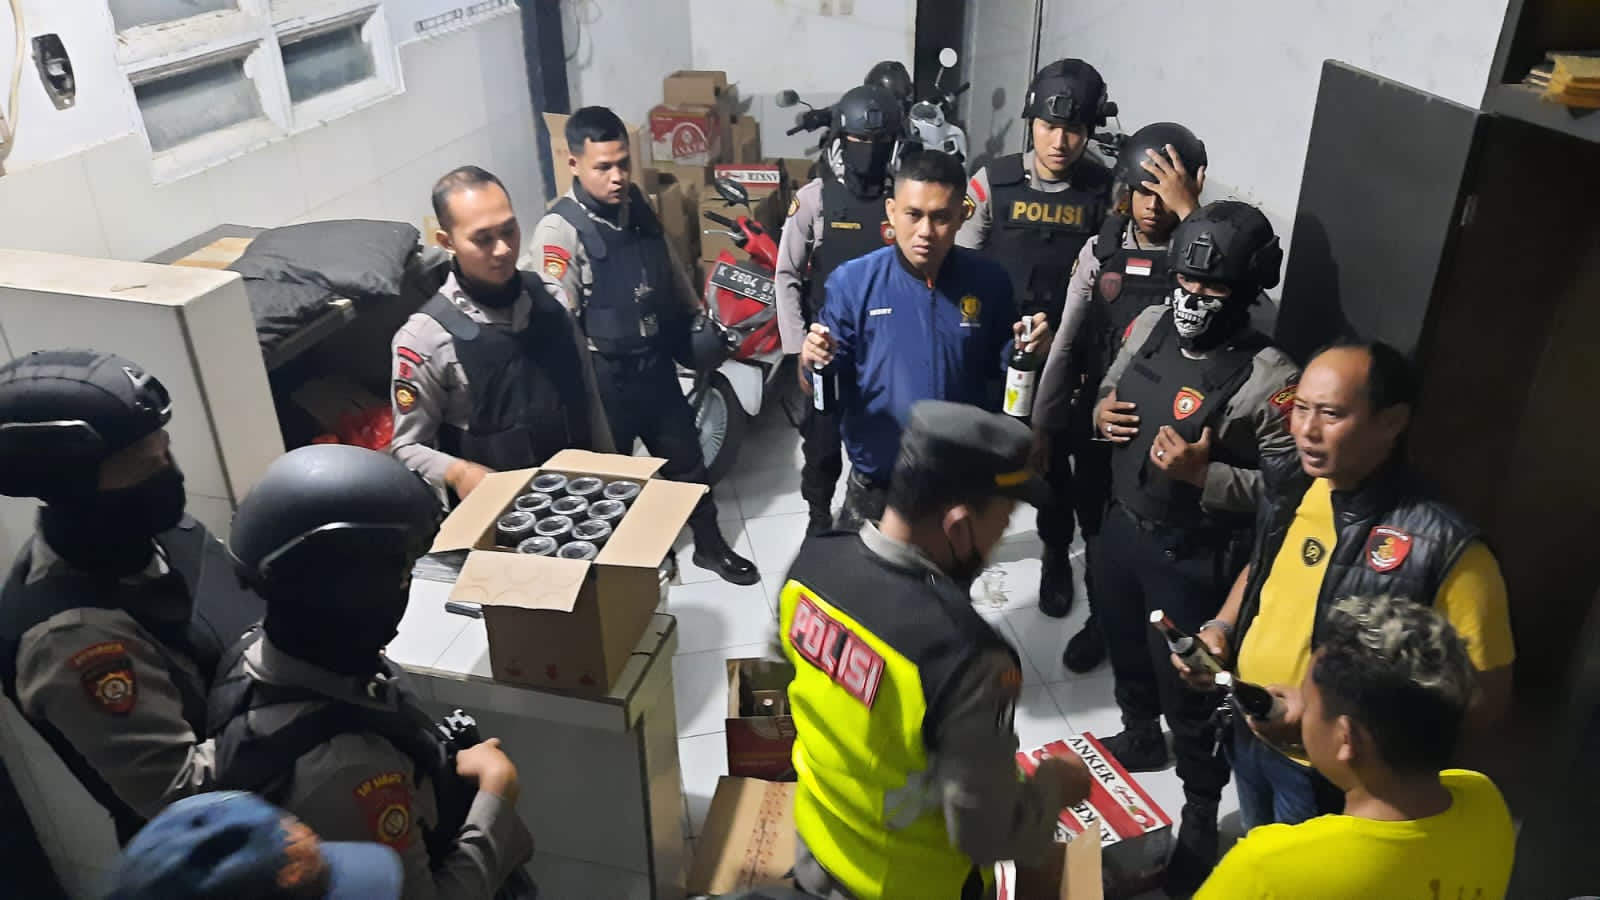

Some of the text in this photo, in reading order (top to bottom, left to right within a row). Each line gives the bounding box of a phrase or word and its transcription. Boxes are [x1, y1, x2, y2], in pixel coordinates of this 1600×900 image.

[1012, 201, 1082, 225] POLISI
[717, 265, 728, 276] K
[791, 600, 879, 704] POLISI
[1069, 737, 1116, 784] ANKER
